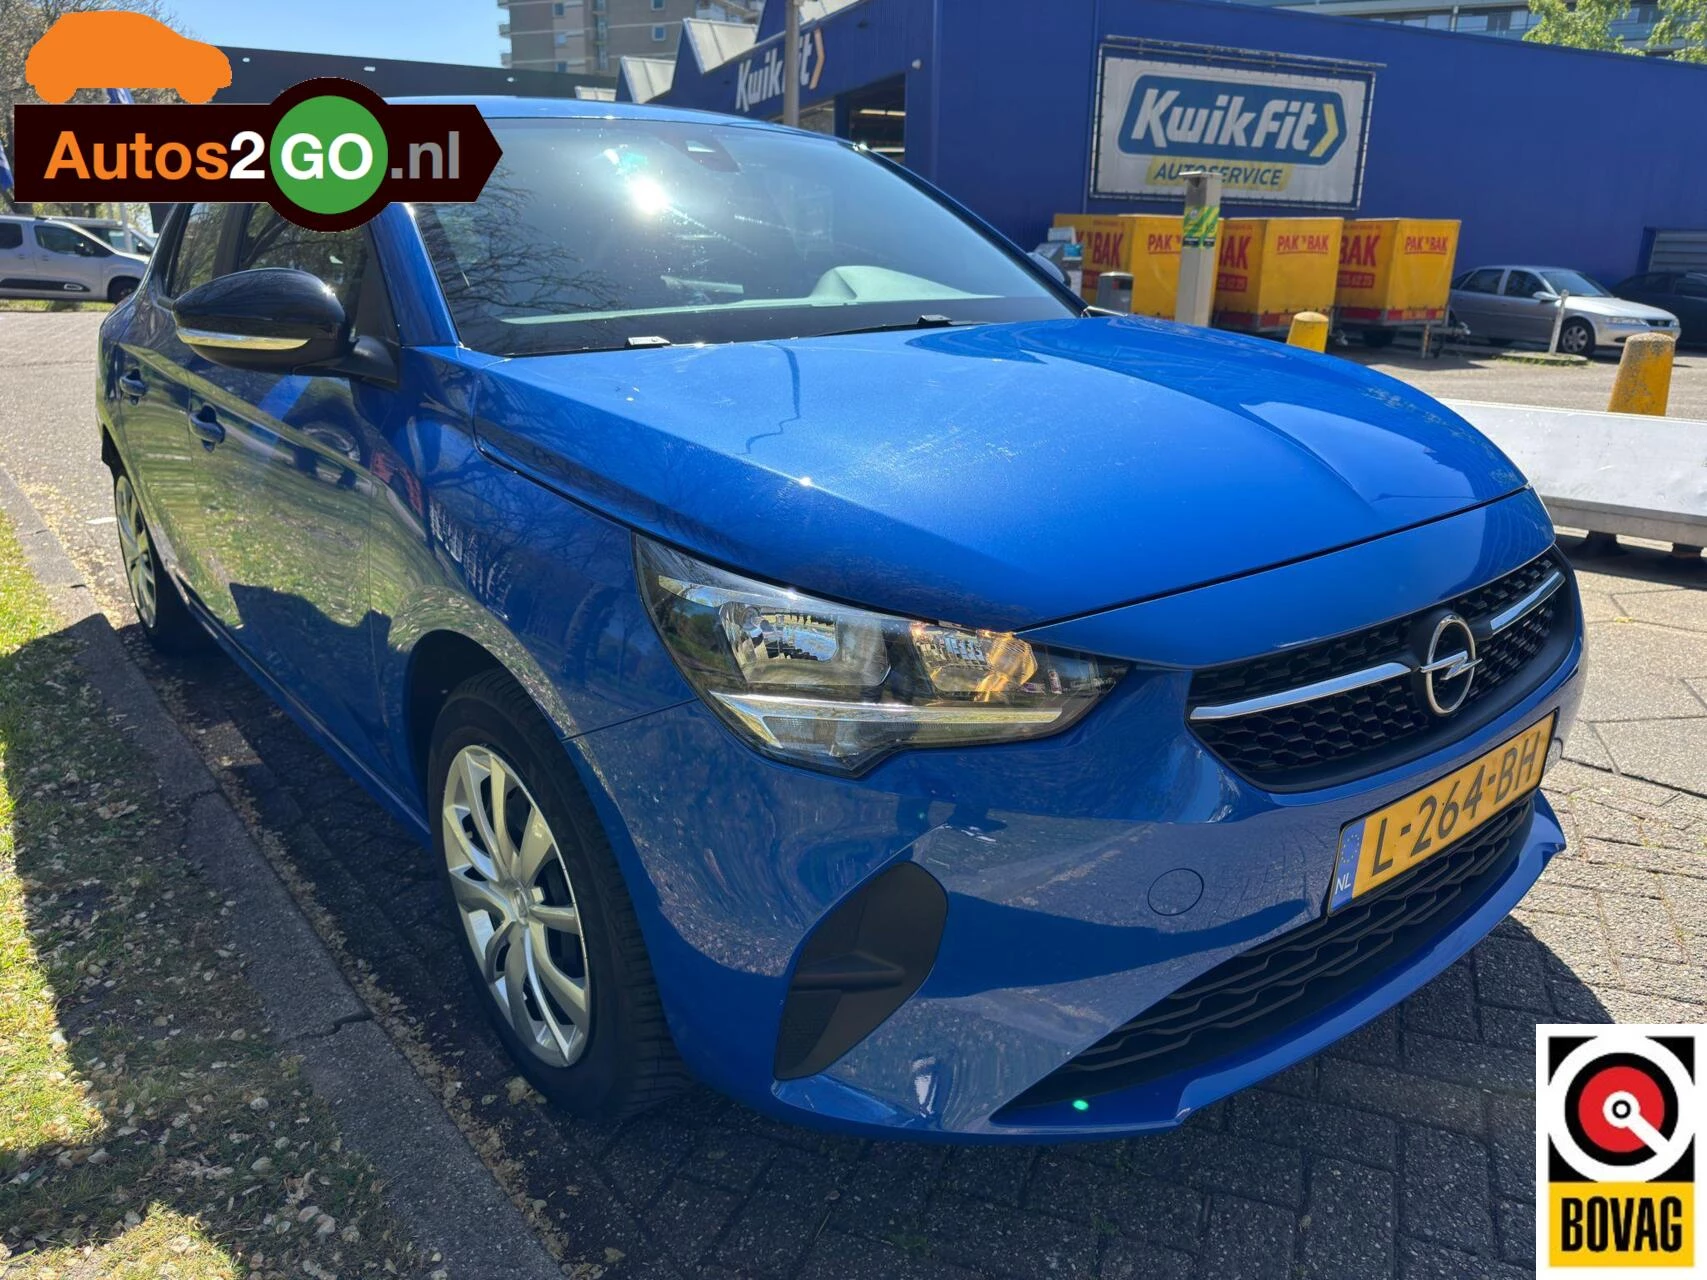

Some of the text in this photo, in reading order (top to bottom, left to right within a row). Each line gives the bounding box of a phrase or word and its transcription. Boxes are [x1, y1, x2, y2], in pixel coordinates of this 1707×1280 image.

[1219, 235, 1252, 270] AK
[1371, 730, 1541, 877] L-264-BH
[1334, 874, 1352, 895] NL
